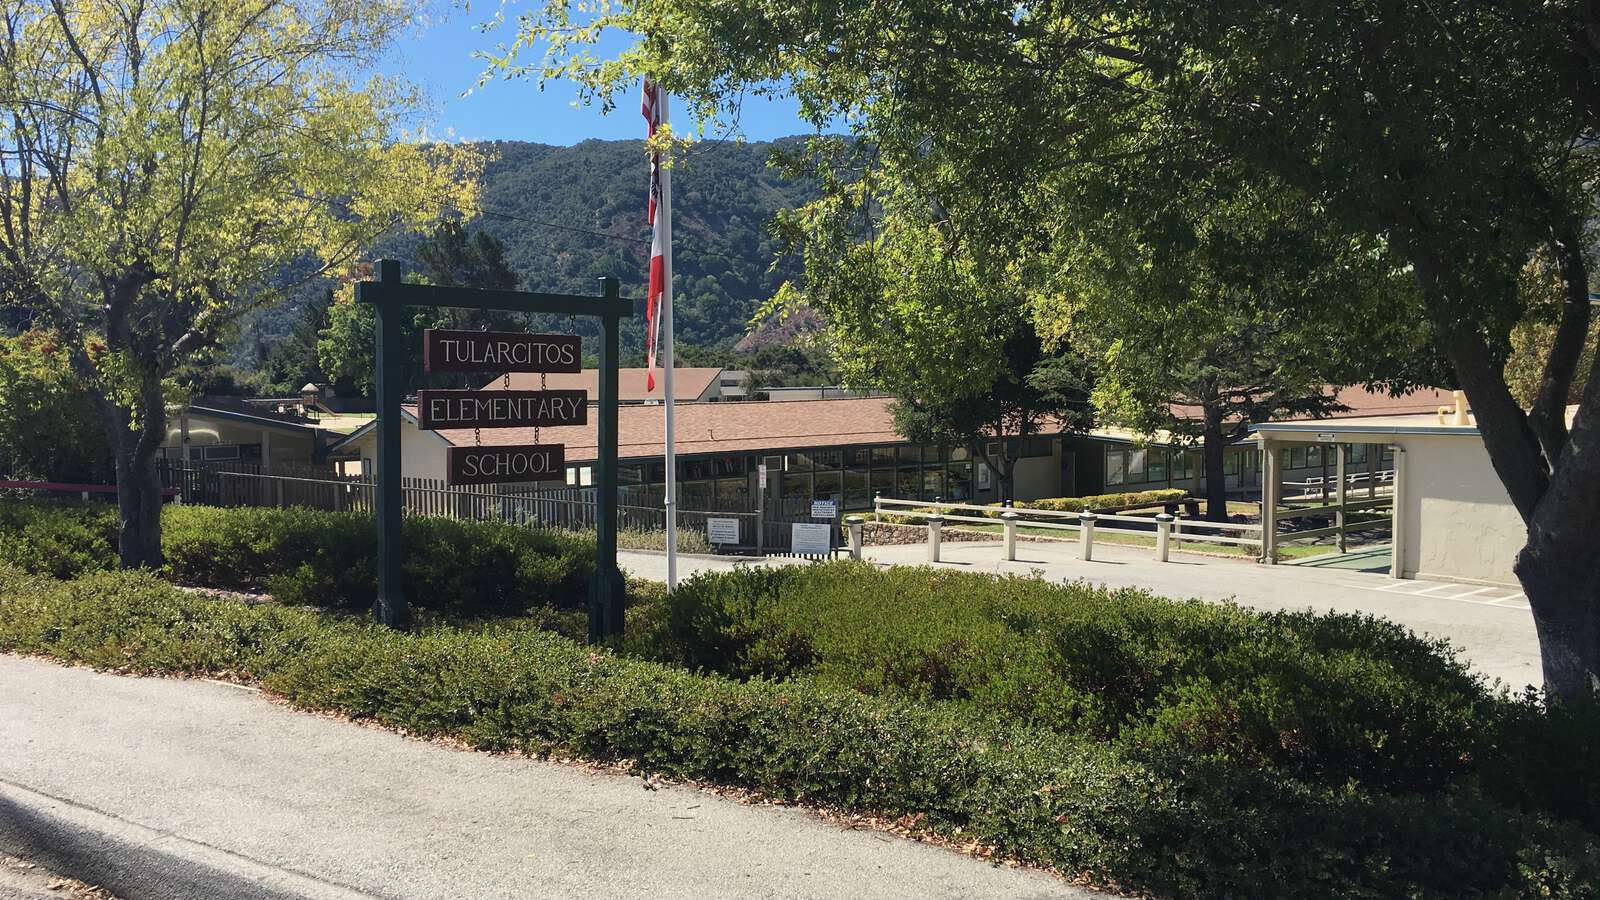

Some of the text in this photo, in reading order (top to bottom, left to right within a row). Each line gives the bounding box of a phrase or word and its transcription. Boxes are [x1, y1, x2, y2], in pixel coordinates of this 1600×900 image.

[440, 340, 574, 364] TULARCITOS
[431, 398, 582, 421] ELEMENTARY
[462, 453, 557, 476] SCHOOL
